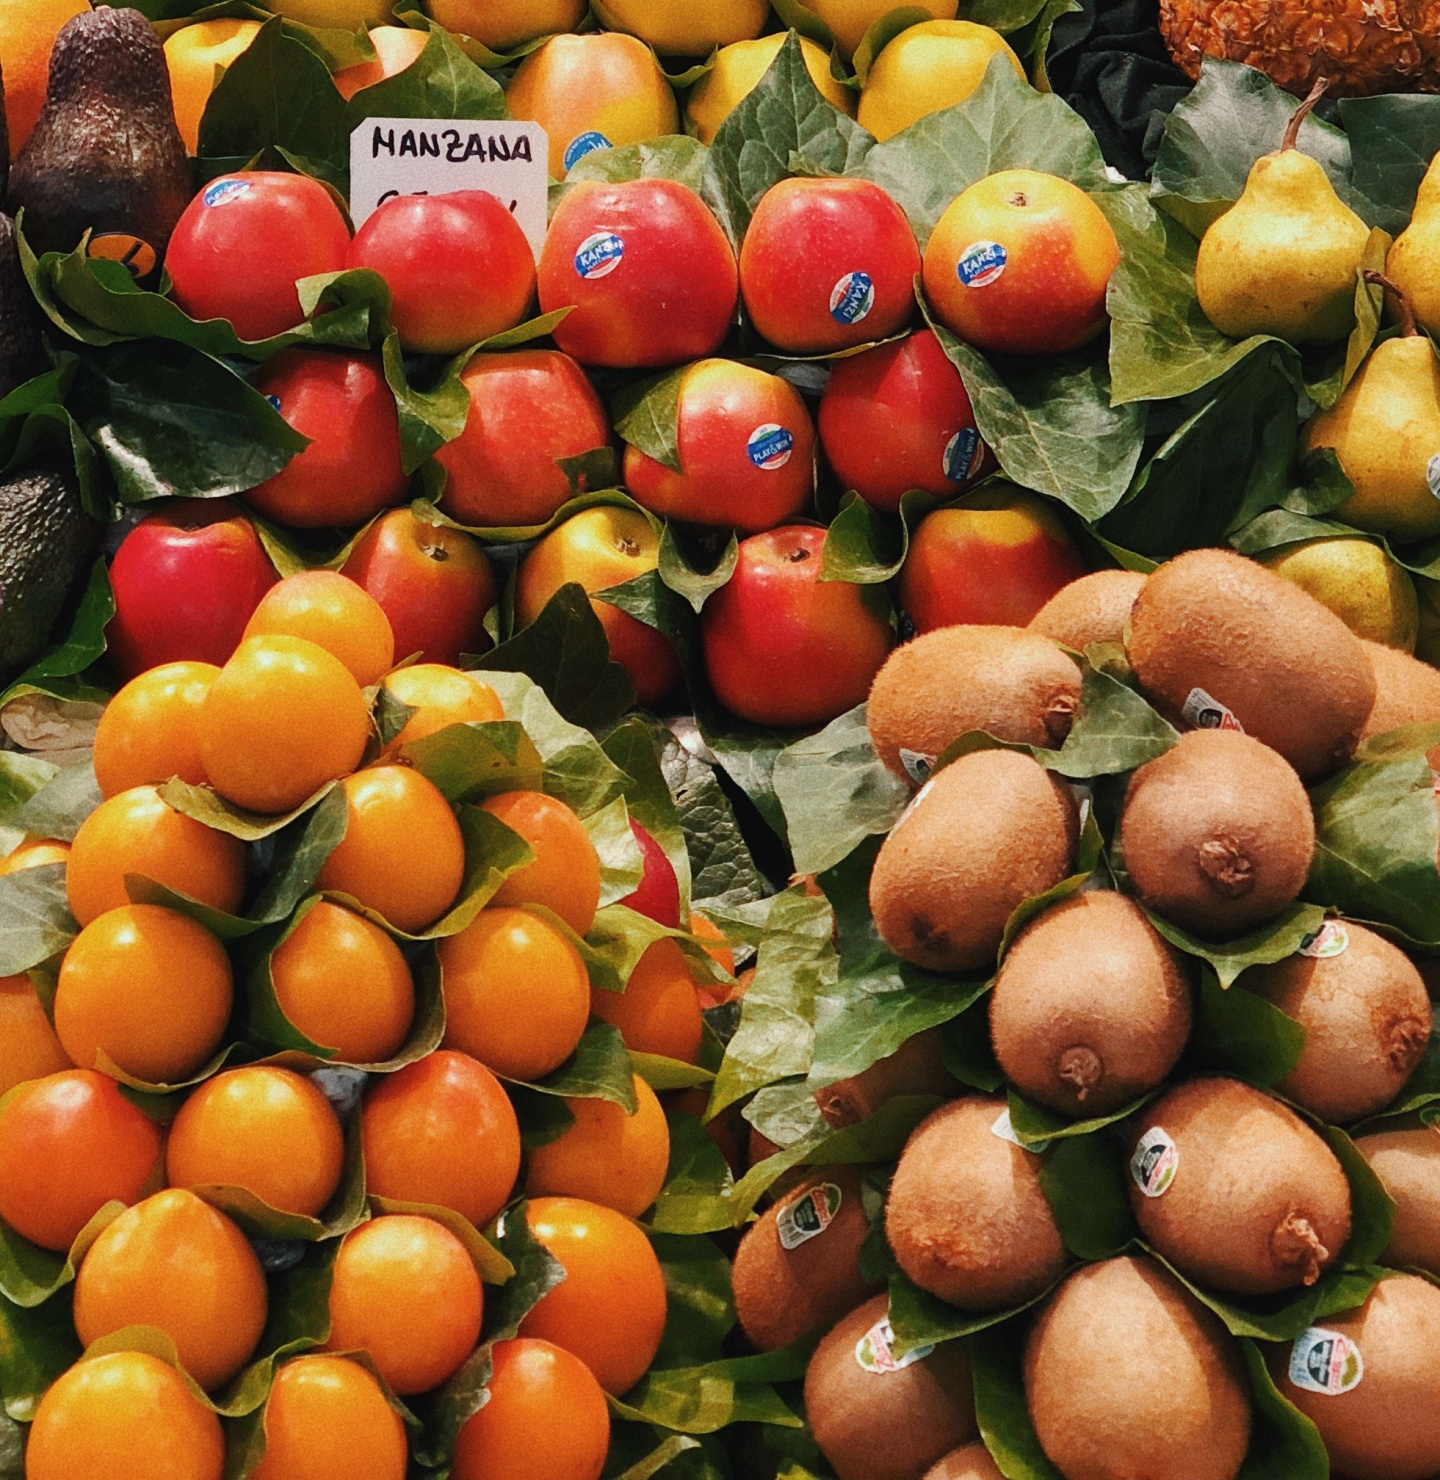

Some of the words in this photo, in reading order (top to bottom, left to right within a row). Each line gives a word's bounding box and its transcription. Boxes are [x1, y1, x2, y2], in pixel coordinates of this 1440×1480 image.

[372, 125, 533, 163] MANZANA
[962, 246, 997, 275] KANZI
[842, 281, 869, 320] KANZI
